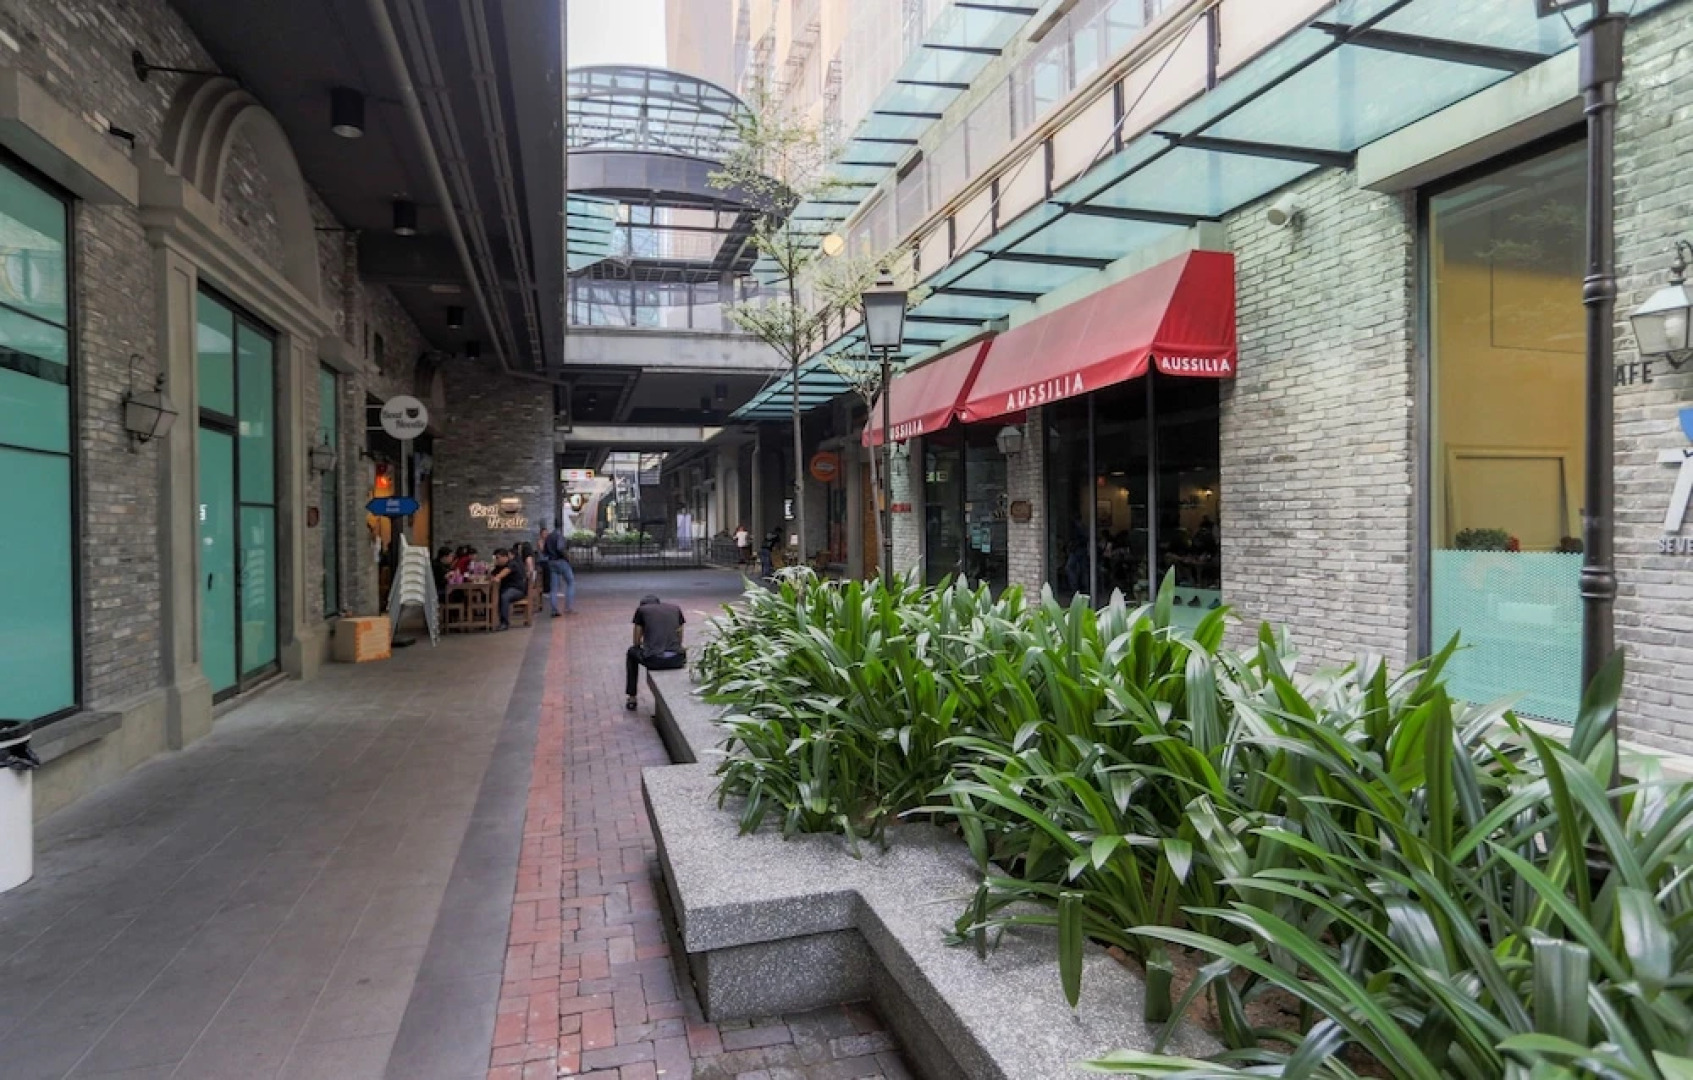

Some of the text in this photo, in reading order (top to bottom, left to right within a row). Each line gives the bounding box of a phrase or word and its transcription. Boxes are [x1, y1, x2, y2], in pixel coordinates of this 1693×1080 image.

[1162, 357, 1231, 372] AUSSILIA
[1613, 362, 1653, 387] AFE
[1006, 373, 1083, 411] AUSSILIA
